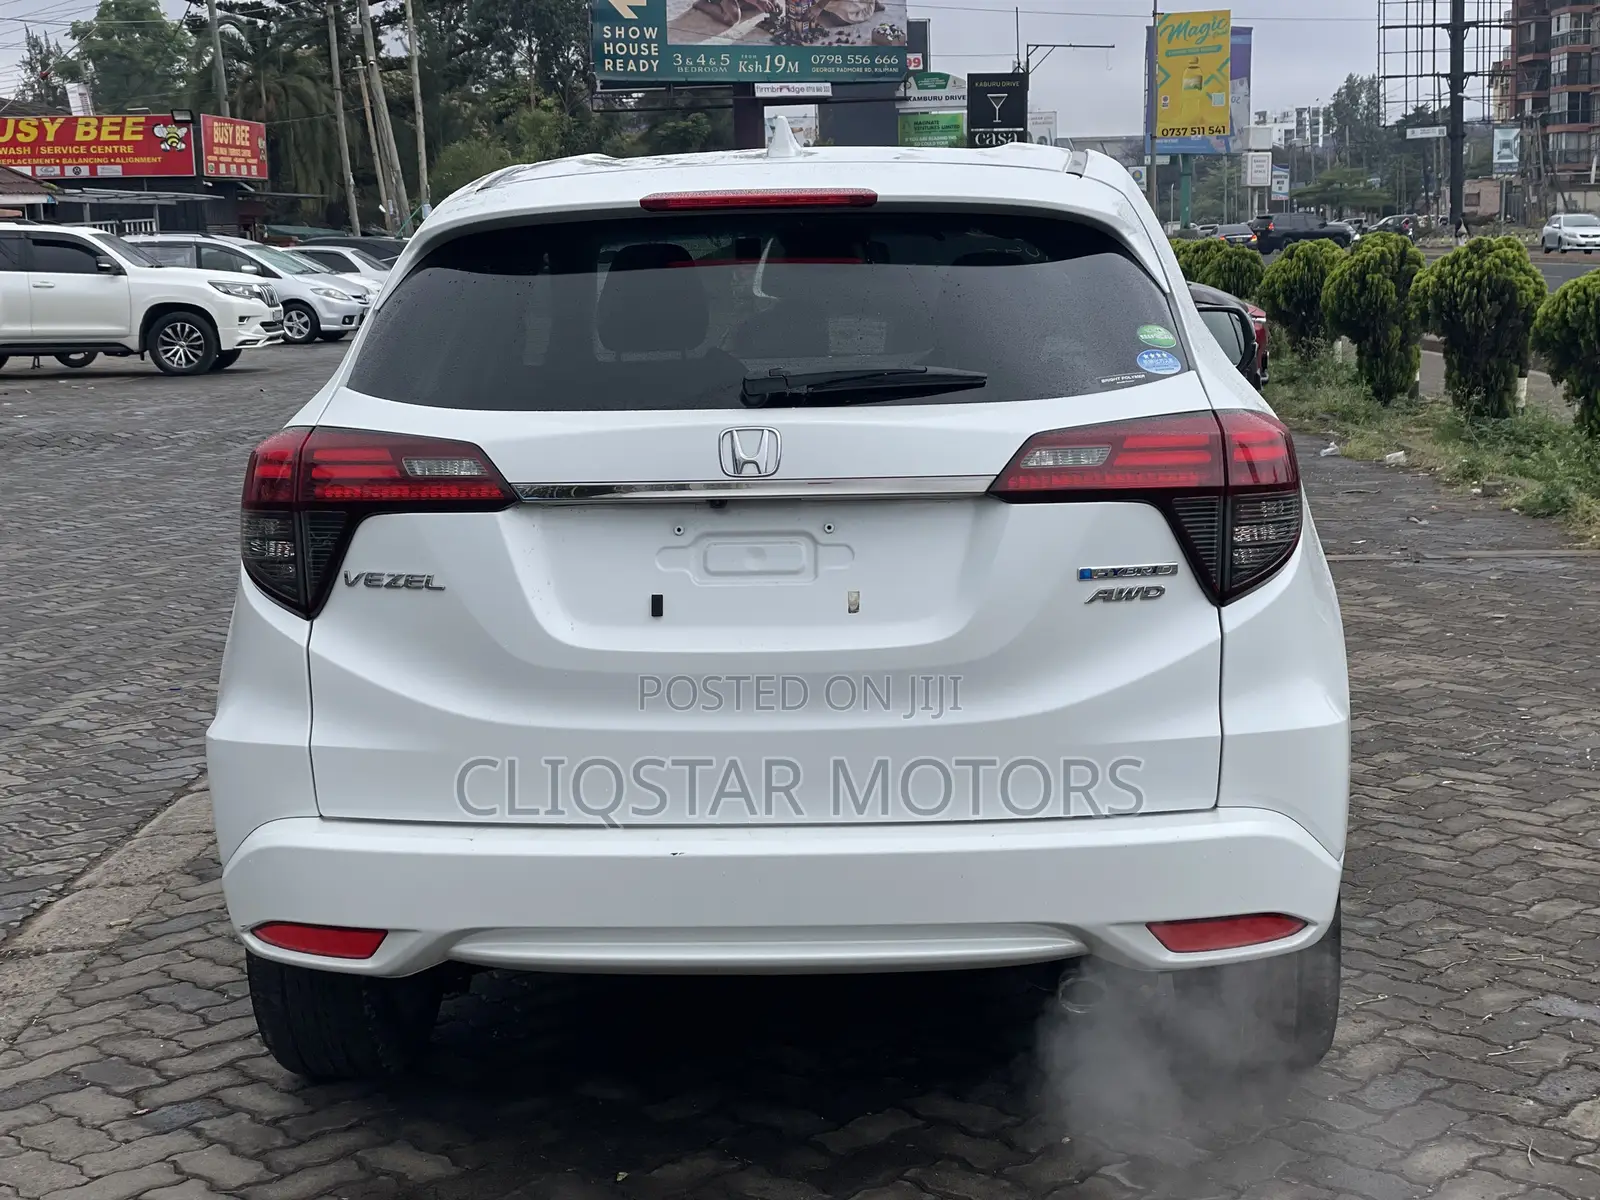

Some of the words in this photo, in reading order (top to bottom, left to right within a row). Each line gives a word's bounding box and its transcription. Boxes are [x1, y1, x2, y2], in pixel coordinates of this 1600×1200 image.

[603, 26, 658, 39] SHOW
[1159, 16, 1228, 45] Magic
[604, 42, 659, 56] HOUSE
[604, 59, 660, 72] READY
[673, 53, 683, 66] 3
[685, 57, 693, 66] &
[696, 53, 706, 66] 4
[709, 57, 717, 66] &
[720, 53, 730, 66] 5
[811, 54, 843, 65] 0798
[847, 54, 871, 65] 556
[874, 54, 899, 65] 666
[75, 116, 146, 142] BEE
[213, 121, 234, 145] BUSY
[235, 125, 250, 146] BEE
[1161, 128, 1188, 137] 0737
[1190, 126, 1205, 136] 511
[1208, 125, 1226, 135] 541
[90, 145, 135, 154] CENTRE
[62, 157, 109, 165] BALANCING
[115, 156, 163, 164] ALIGNMENT
[1093, 563, 1174, 579] HYBRID
[343, 570, 446, 591] VEZEL
[1084, 584, 1166, 605] AWD
